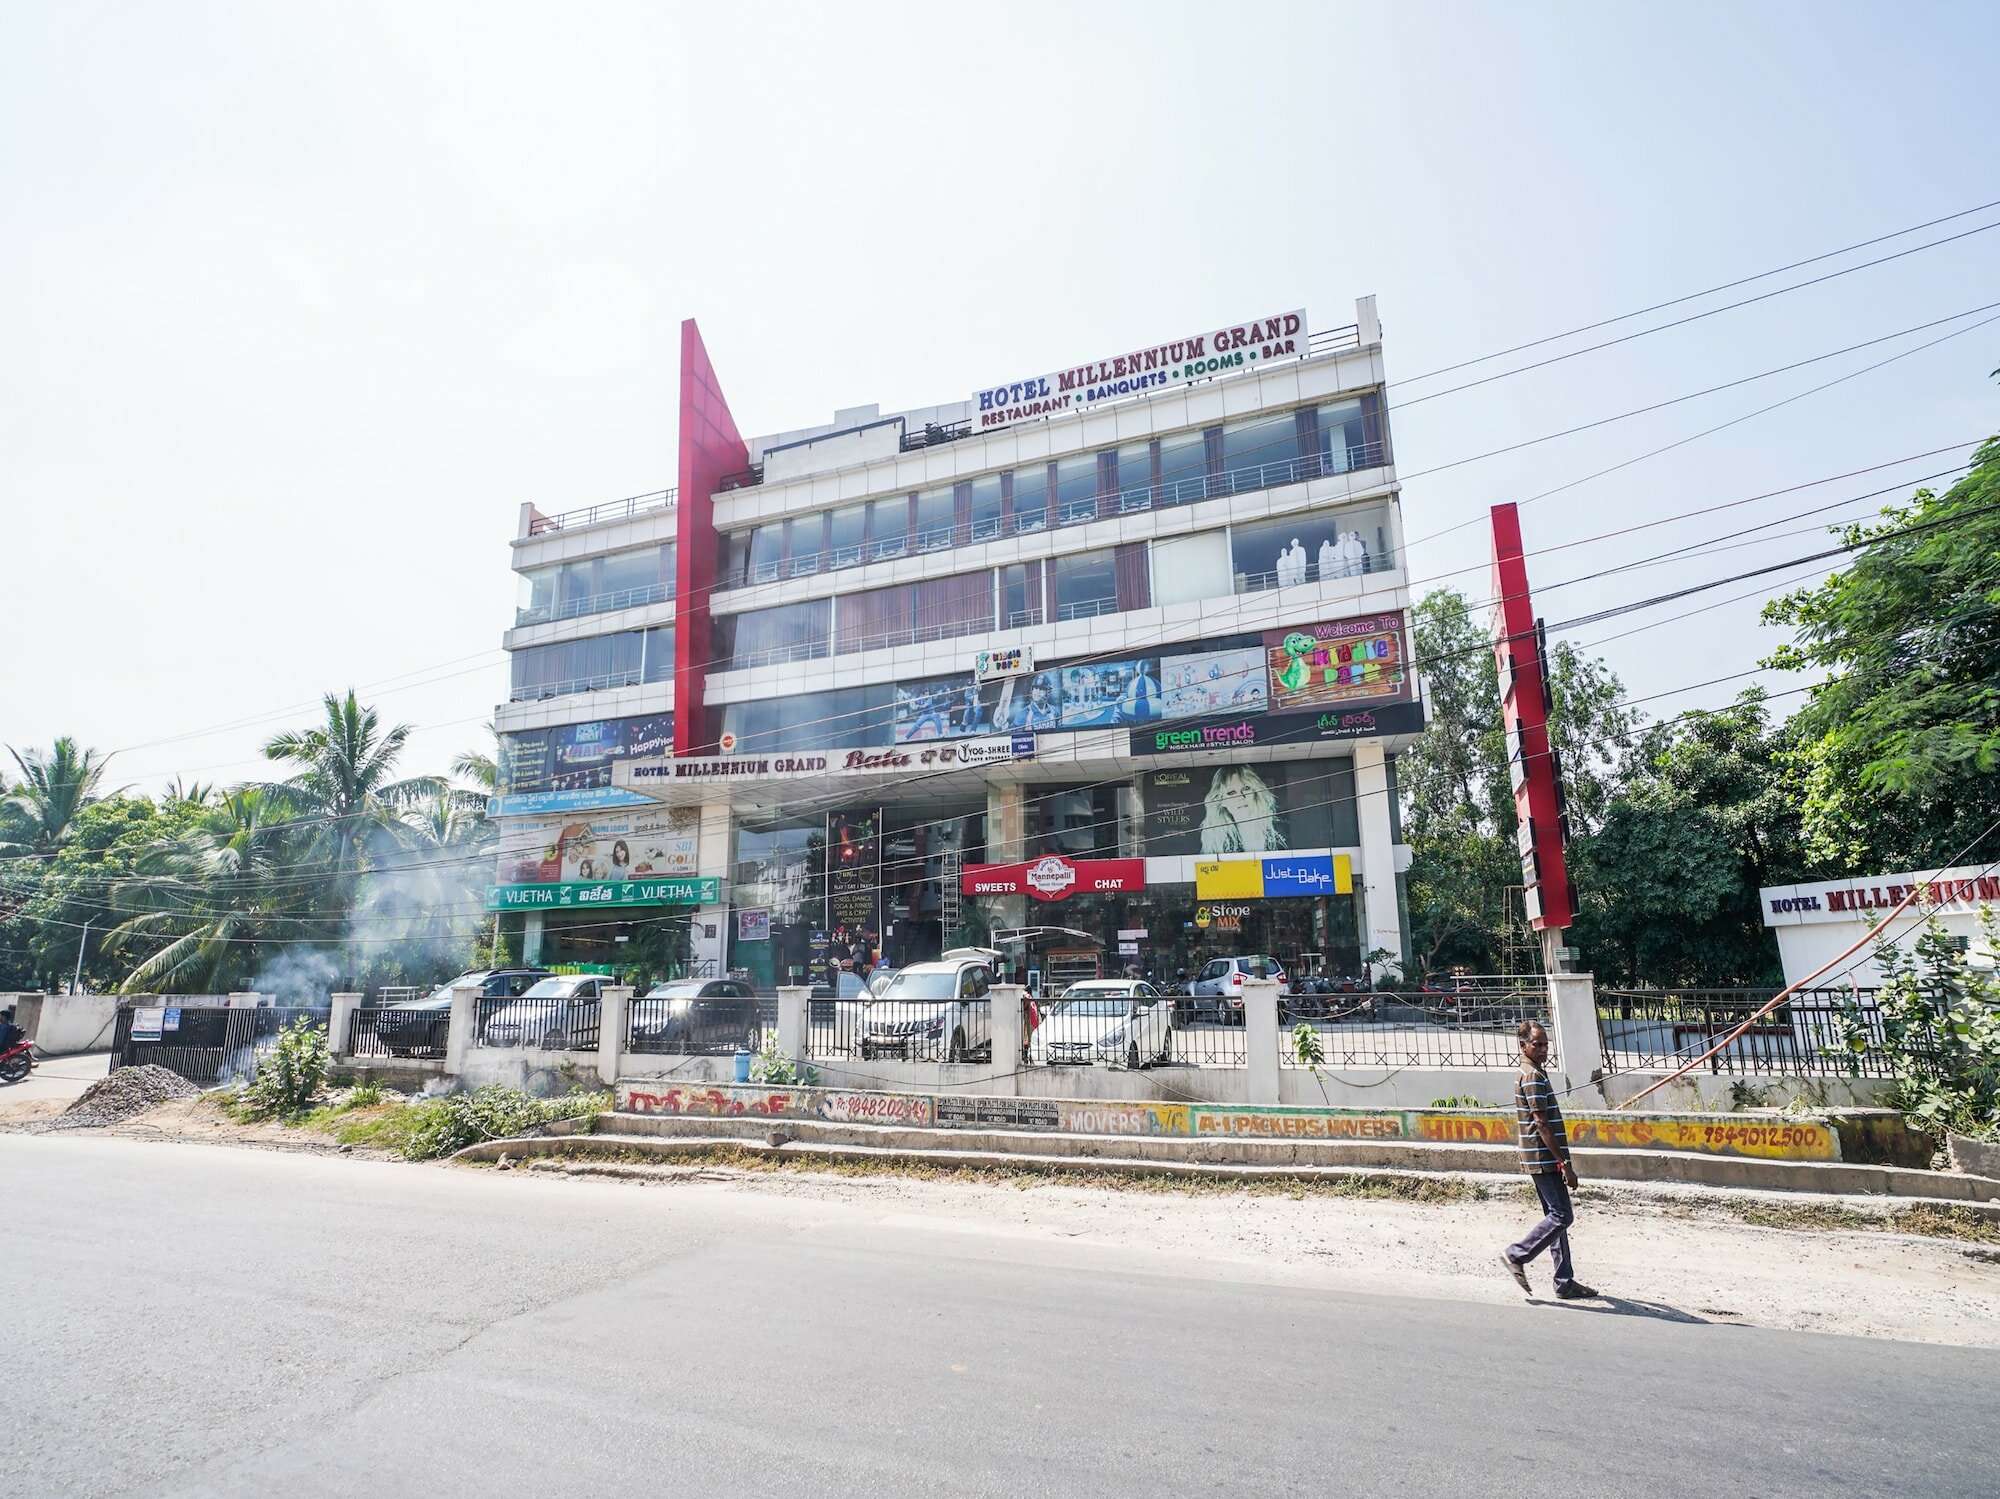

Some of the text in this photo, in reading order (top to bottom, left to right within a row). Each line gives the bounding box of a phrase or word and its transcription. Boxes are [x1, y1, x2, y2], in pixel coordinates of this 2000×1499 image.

[979, 314, 1300, 411] HOTEL MILLENNIUM GRAND
[982, 340, 1295, 426] RESTAURANT BANQUETS ROOMS BAR
[1315, 616, 1398, 638] Welcome To
[1155, 721, 1255, 750] green trends
[630, 737, 661, 755] Happy
[633, 757, 827, 777] HOTEL MILLENNIUM GRAND
[842, 749, 912, 769] Bata
[674, 841, 692, 852] SBI
[974, 871, 1123, 892] SWEETS Mannepalli CHAT
[1265, 864, 1332, 889] Just Bake
[506, 889, 552, 903] VIJETHA
[1770, 896, 1822, 913] HOTEL
[1212, 905, 1251, 917] Stone
[544, 965, 580, 975] ANDI
[1070, 1110, 1141, 1134] MOVERS
[1236, 1117, 1321, 1135] PACKERS
[1423, 1119, 1509, 1141] HUDA
